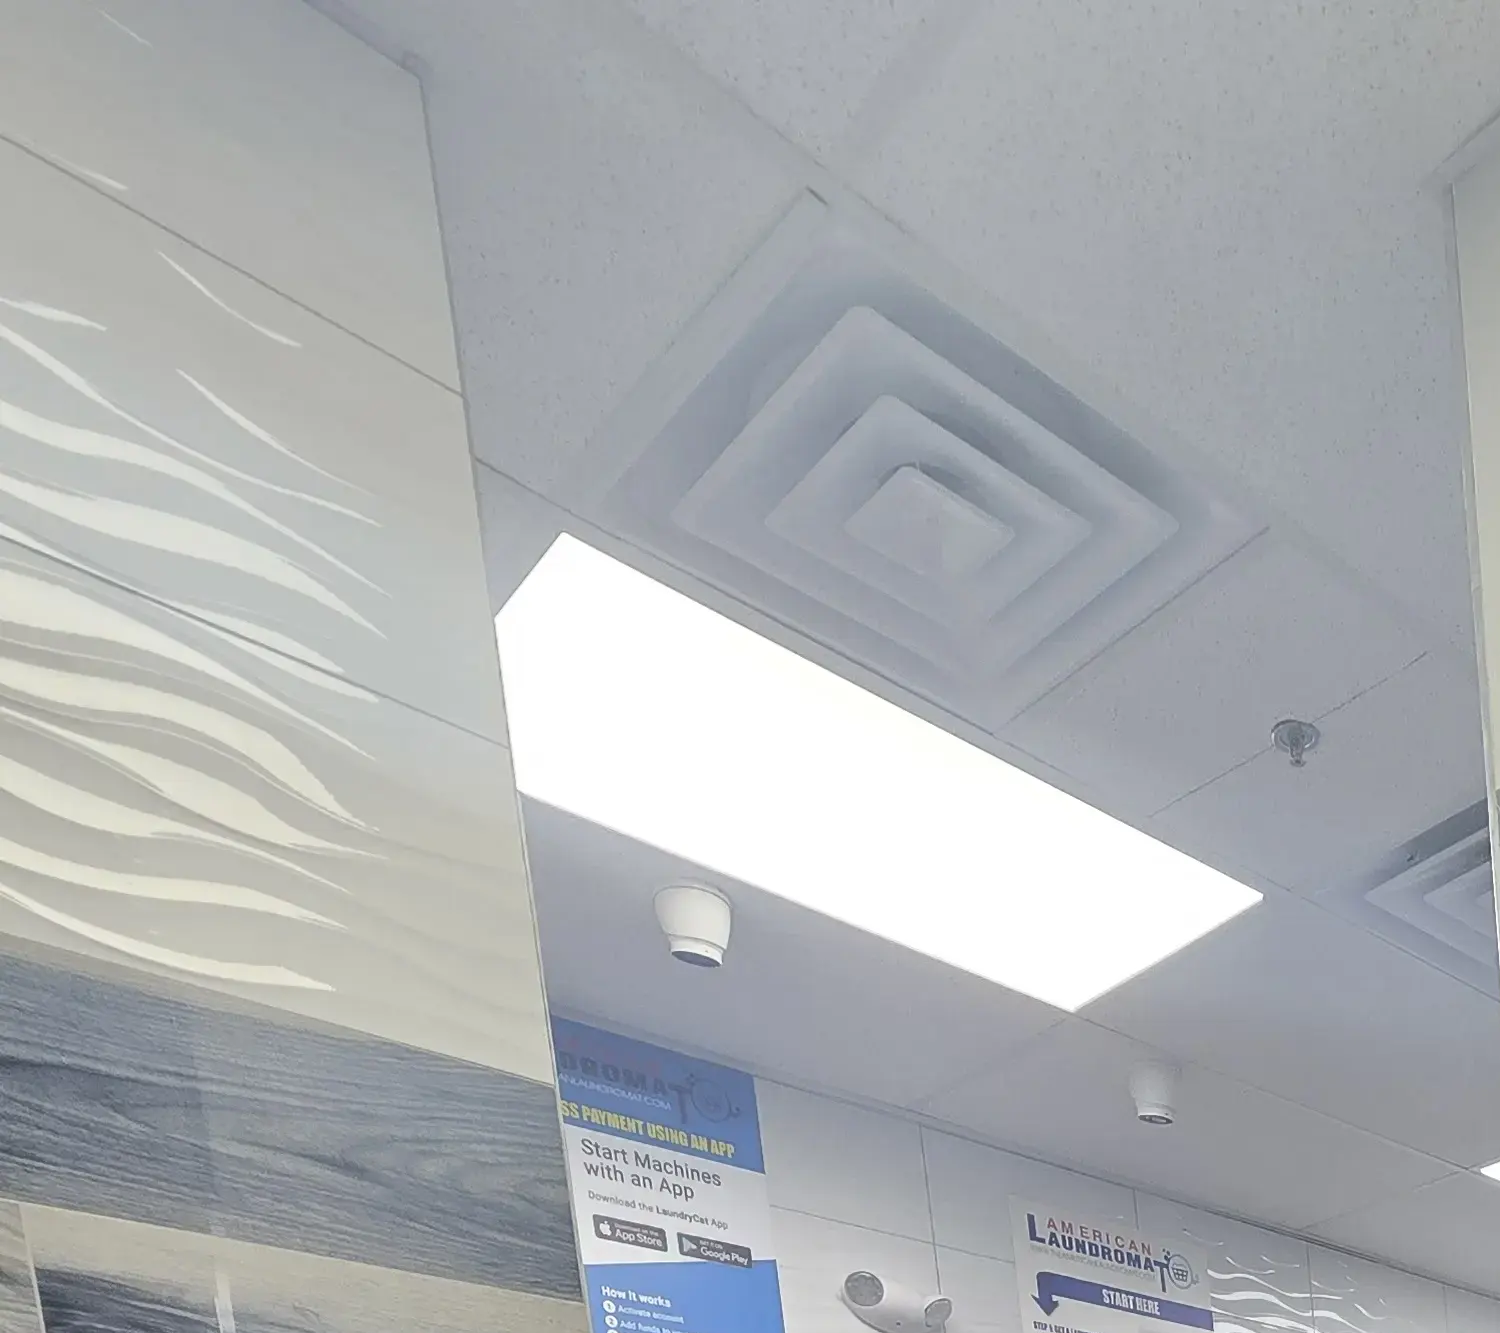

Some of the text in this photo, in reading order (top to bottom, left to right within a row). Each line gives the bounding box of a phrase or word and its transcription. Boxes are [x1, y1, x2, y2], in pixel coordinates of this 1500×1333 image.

[583, 1105, 644, 1135] PAYMENT
[647, 1123, 688, 1147] USING
[690, 1133, 709, 1152] AN
[710, 1139, 734, 1158] APP
[581, 1138, 722, 1187] Start Machines
[584, 1162, 694, 1202] with an App
[588, 1190, 636, 1209] Download
[638, 1202, 653, 1212] the
[711, 1219, 729, 1230] App
[616, 1229, 663, 1247] App Store
[700, 1246, 749, 1266] Google Play
[1027, 1213, 1168, 1293] LAUNDROMAT
[1047, 1217, 1153, 1256] AMERICAN
[601, 1285, 625, 1300] How
[639, 1294, 672, 1308] works
[1102, 1289, 1160, 1316] START HERE
